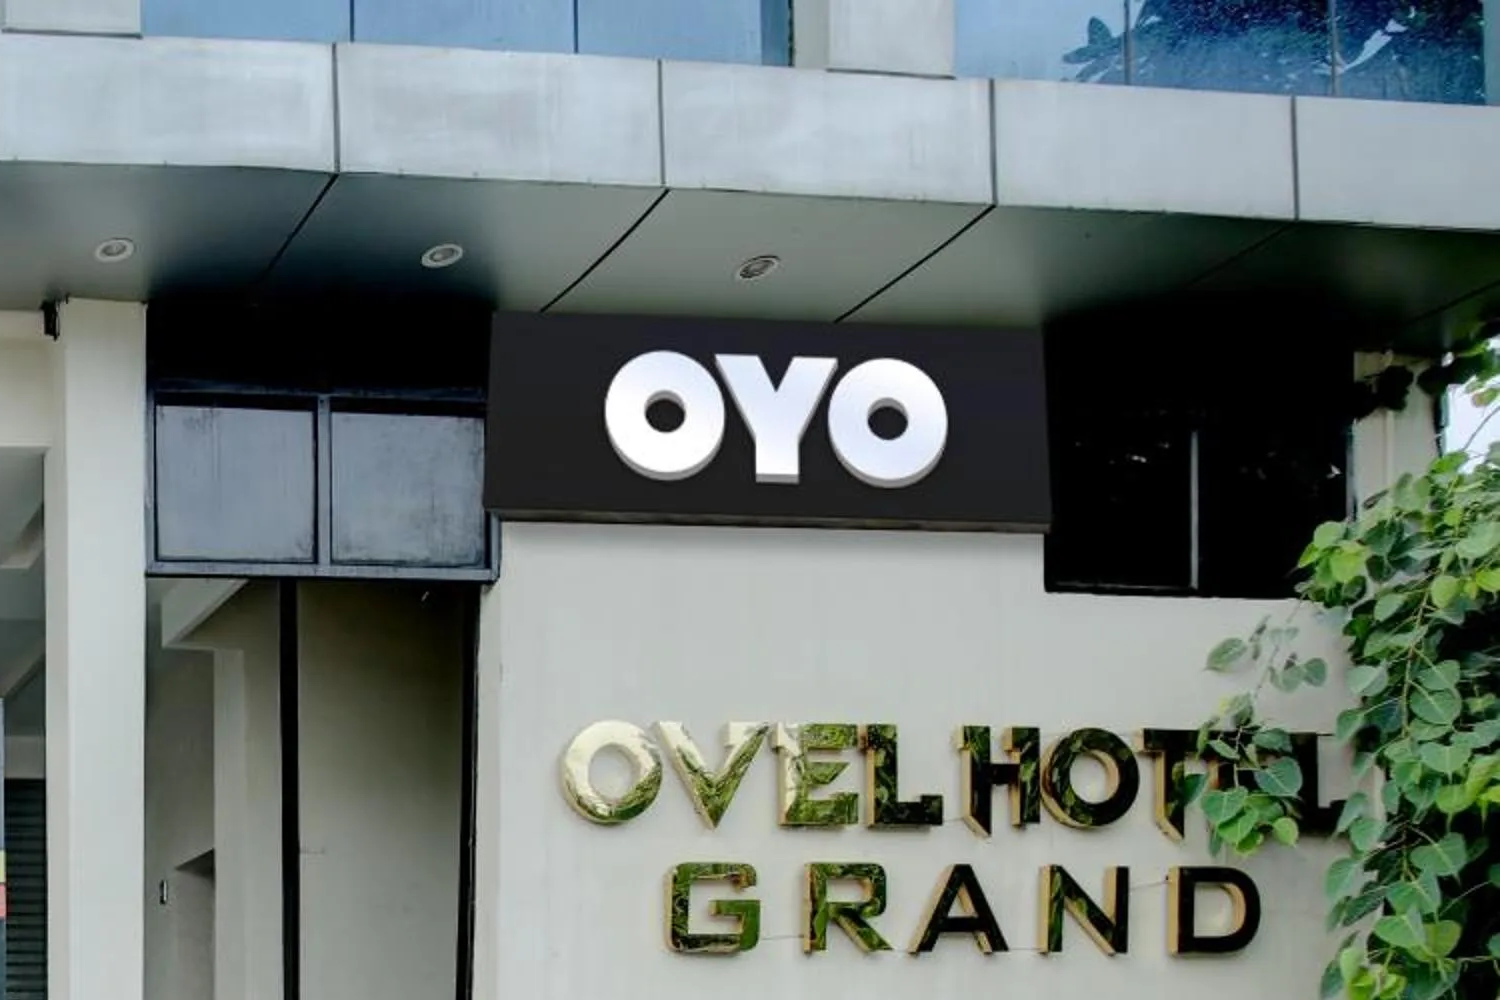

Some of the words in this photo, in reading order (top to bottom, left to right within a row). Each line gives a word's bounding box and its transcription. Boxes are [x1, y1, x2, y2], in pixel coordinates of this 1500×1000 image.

[605, 350, 948, 488] OYO
[557, 720, 943, 830] OVEL
[662, 861, 1263, 956] GRAND
